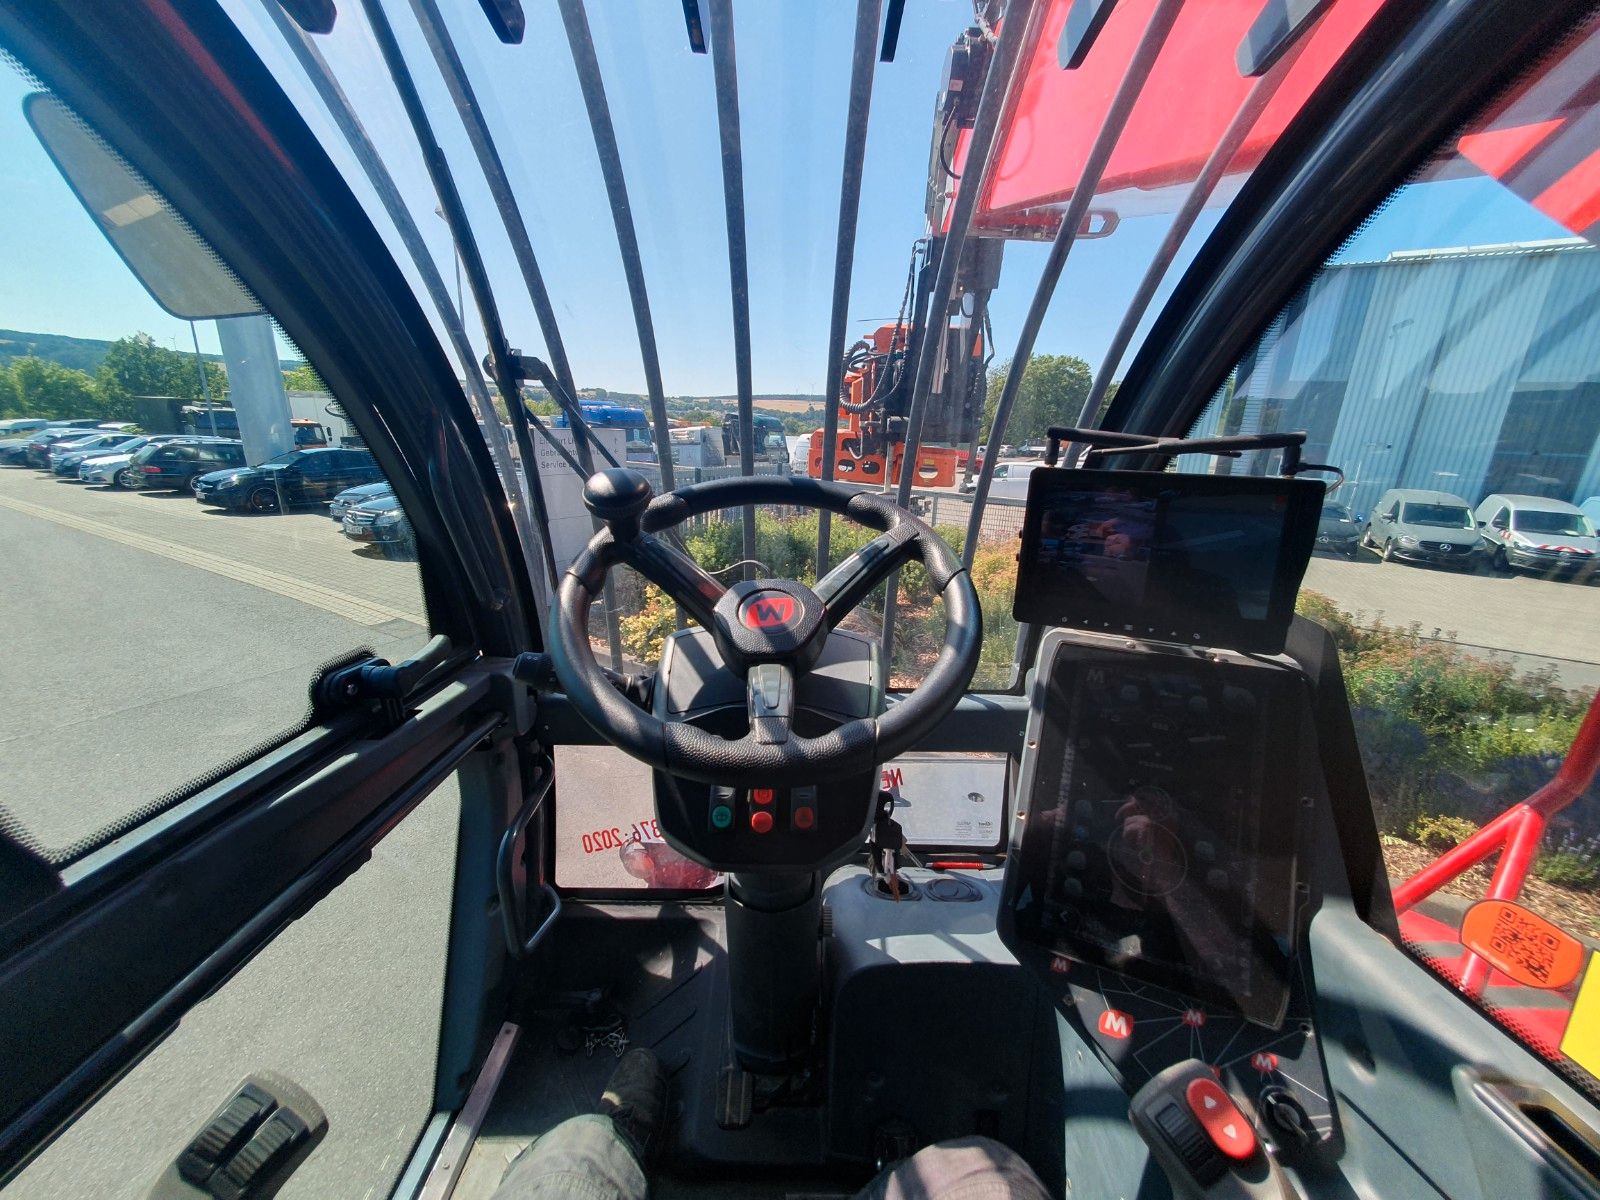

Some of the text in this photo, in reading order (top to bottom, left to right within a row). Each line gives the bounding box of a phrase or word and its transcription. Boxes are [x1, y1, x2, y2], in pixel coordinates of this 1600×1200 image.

[541, 461, 567, 469] Service
[1054, 959, 1066, 971] M
[1188, 1009, 1201, 1023] M
[1104, 1012, 1127, 1035] M
[1256, 1054, 1271, 1069] M
